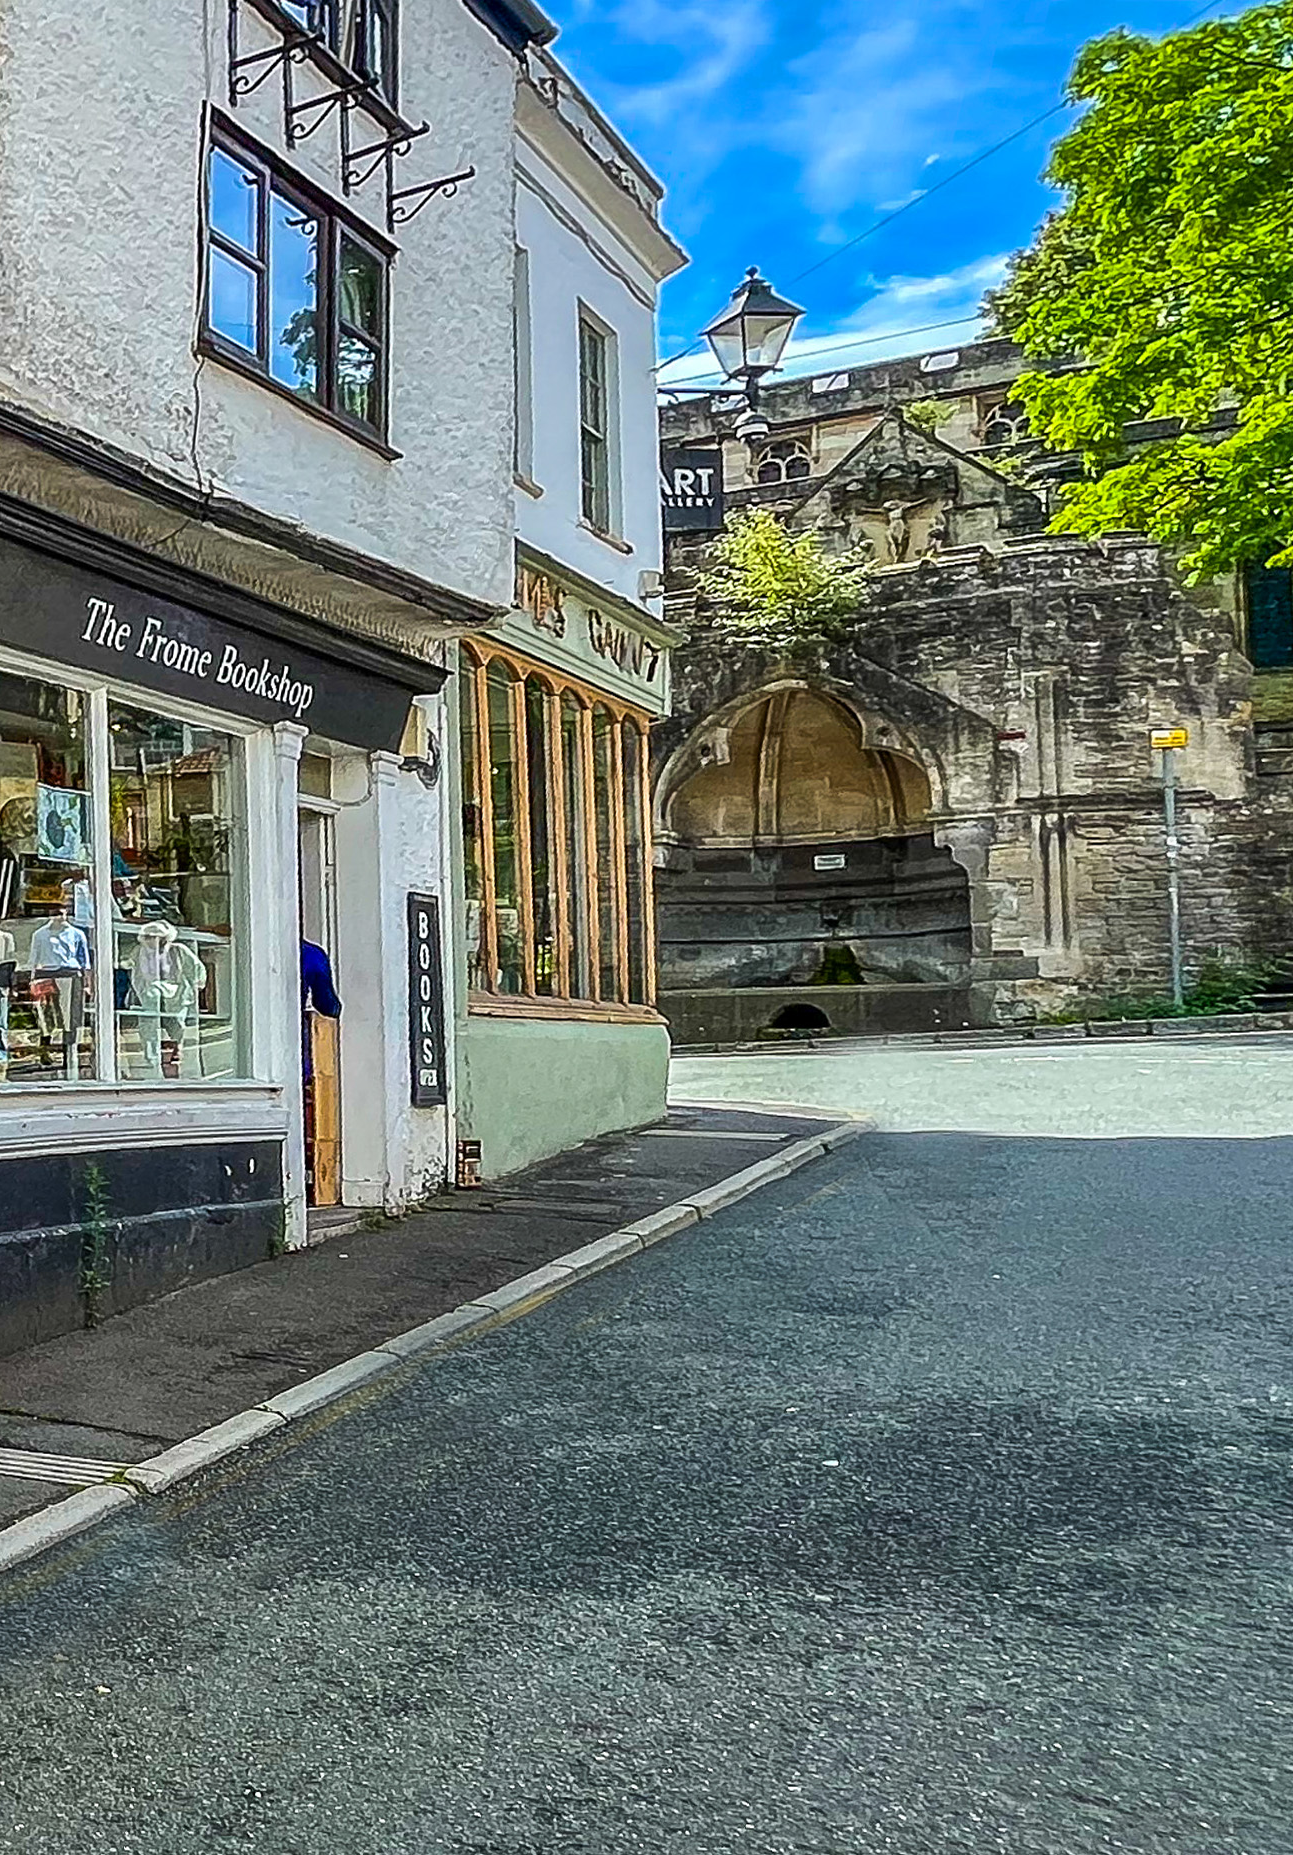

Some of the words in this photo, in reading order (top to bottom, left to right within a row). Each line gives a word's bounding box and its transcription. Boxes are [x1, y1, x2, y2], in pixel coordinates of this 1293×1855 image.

[81, 597, 132, 652] The
[136, 617, 213, 678] Frome
[216, 644, 314, 718] Bookshop
[418, 911, 434, 1064] BOOKS
